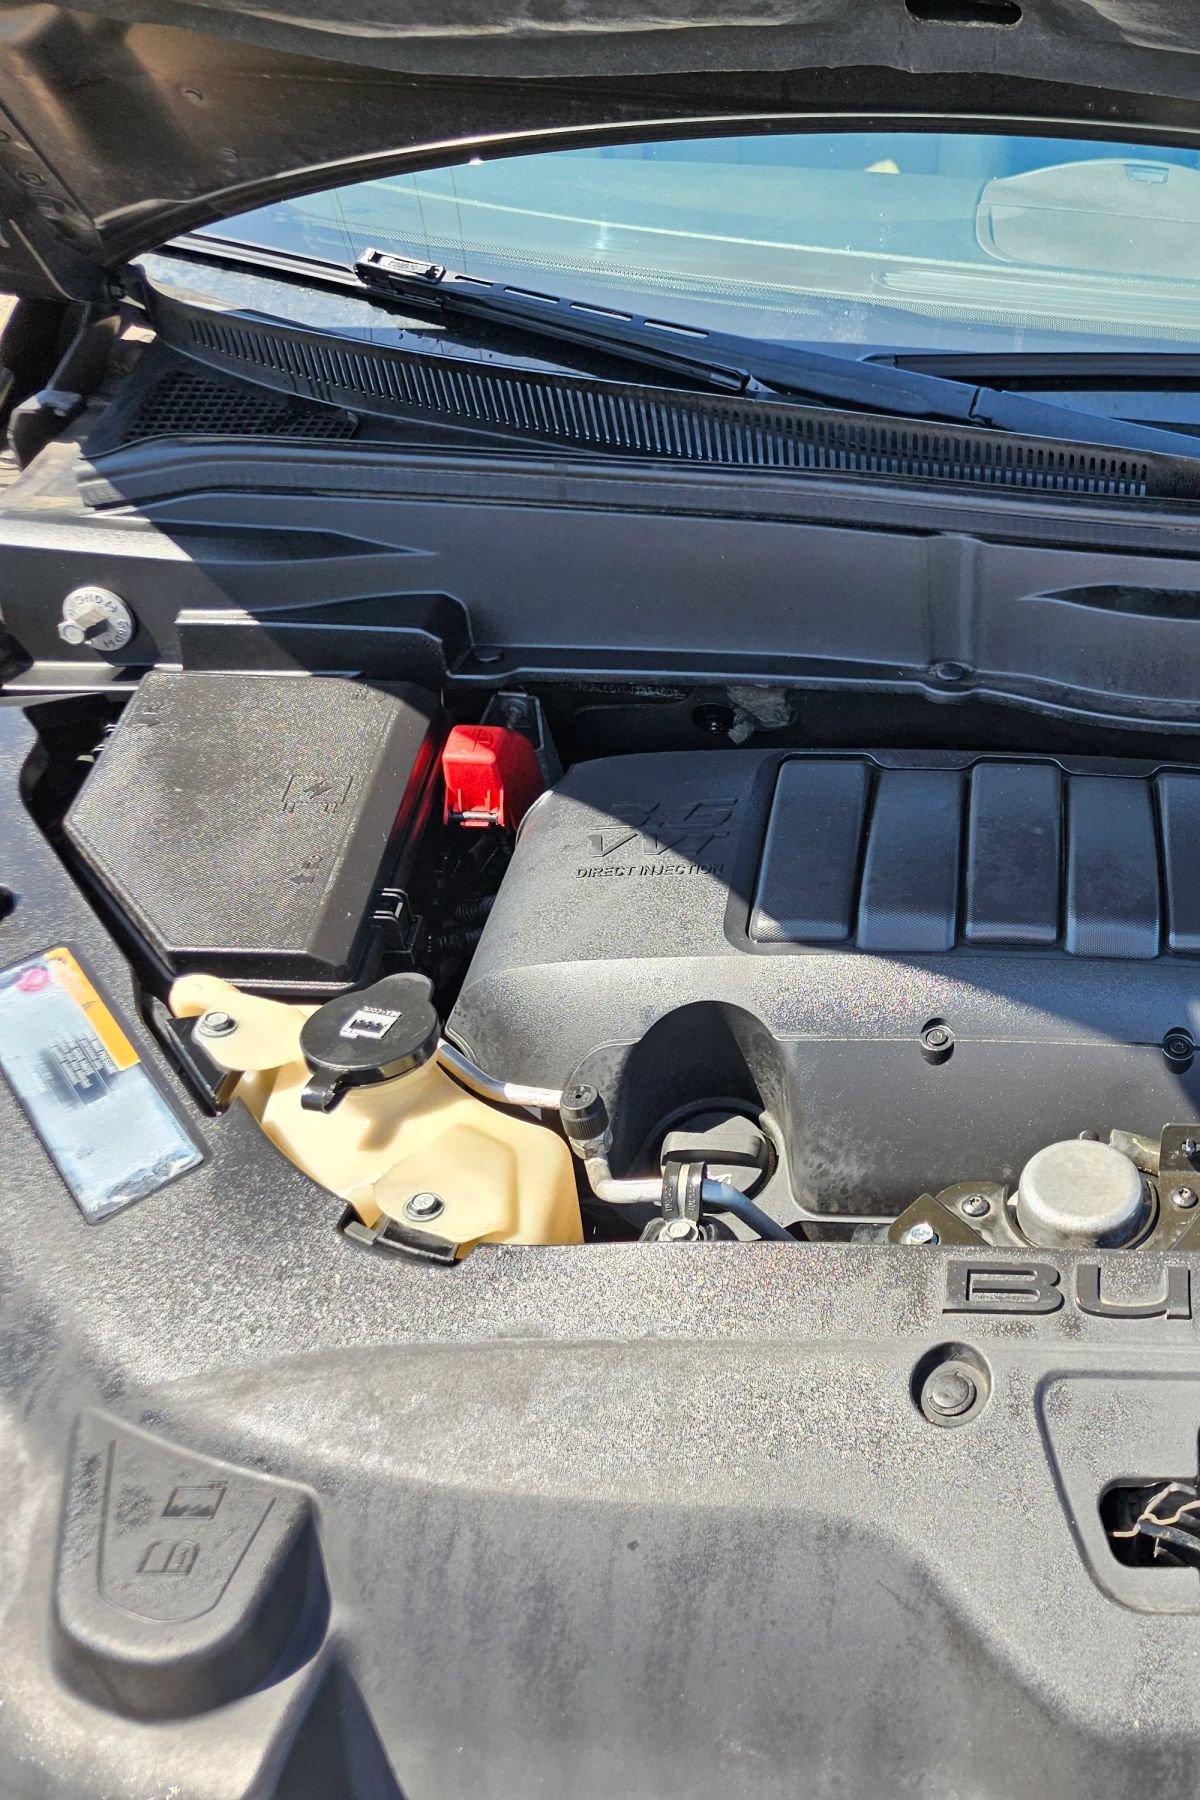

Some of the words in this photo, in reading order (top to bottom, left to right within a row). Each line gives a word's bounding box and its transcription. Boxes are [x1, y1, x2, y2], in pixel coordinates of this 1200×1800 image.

[587, 832, 731, 858] VVT
[576, 866, 636, 879] DIRECT
[639, 864, 725, 877] INJECTION
